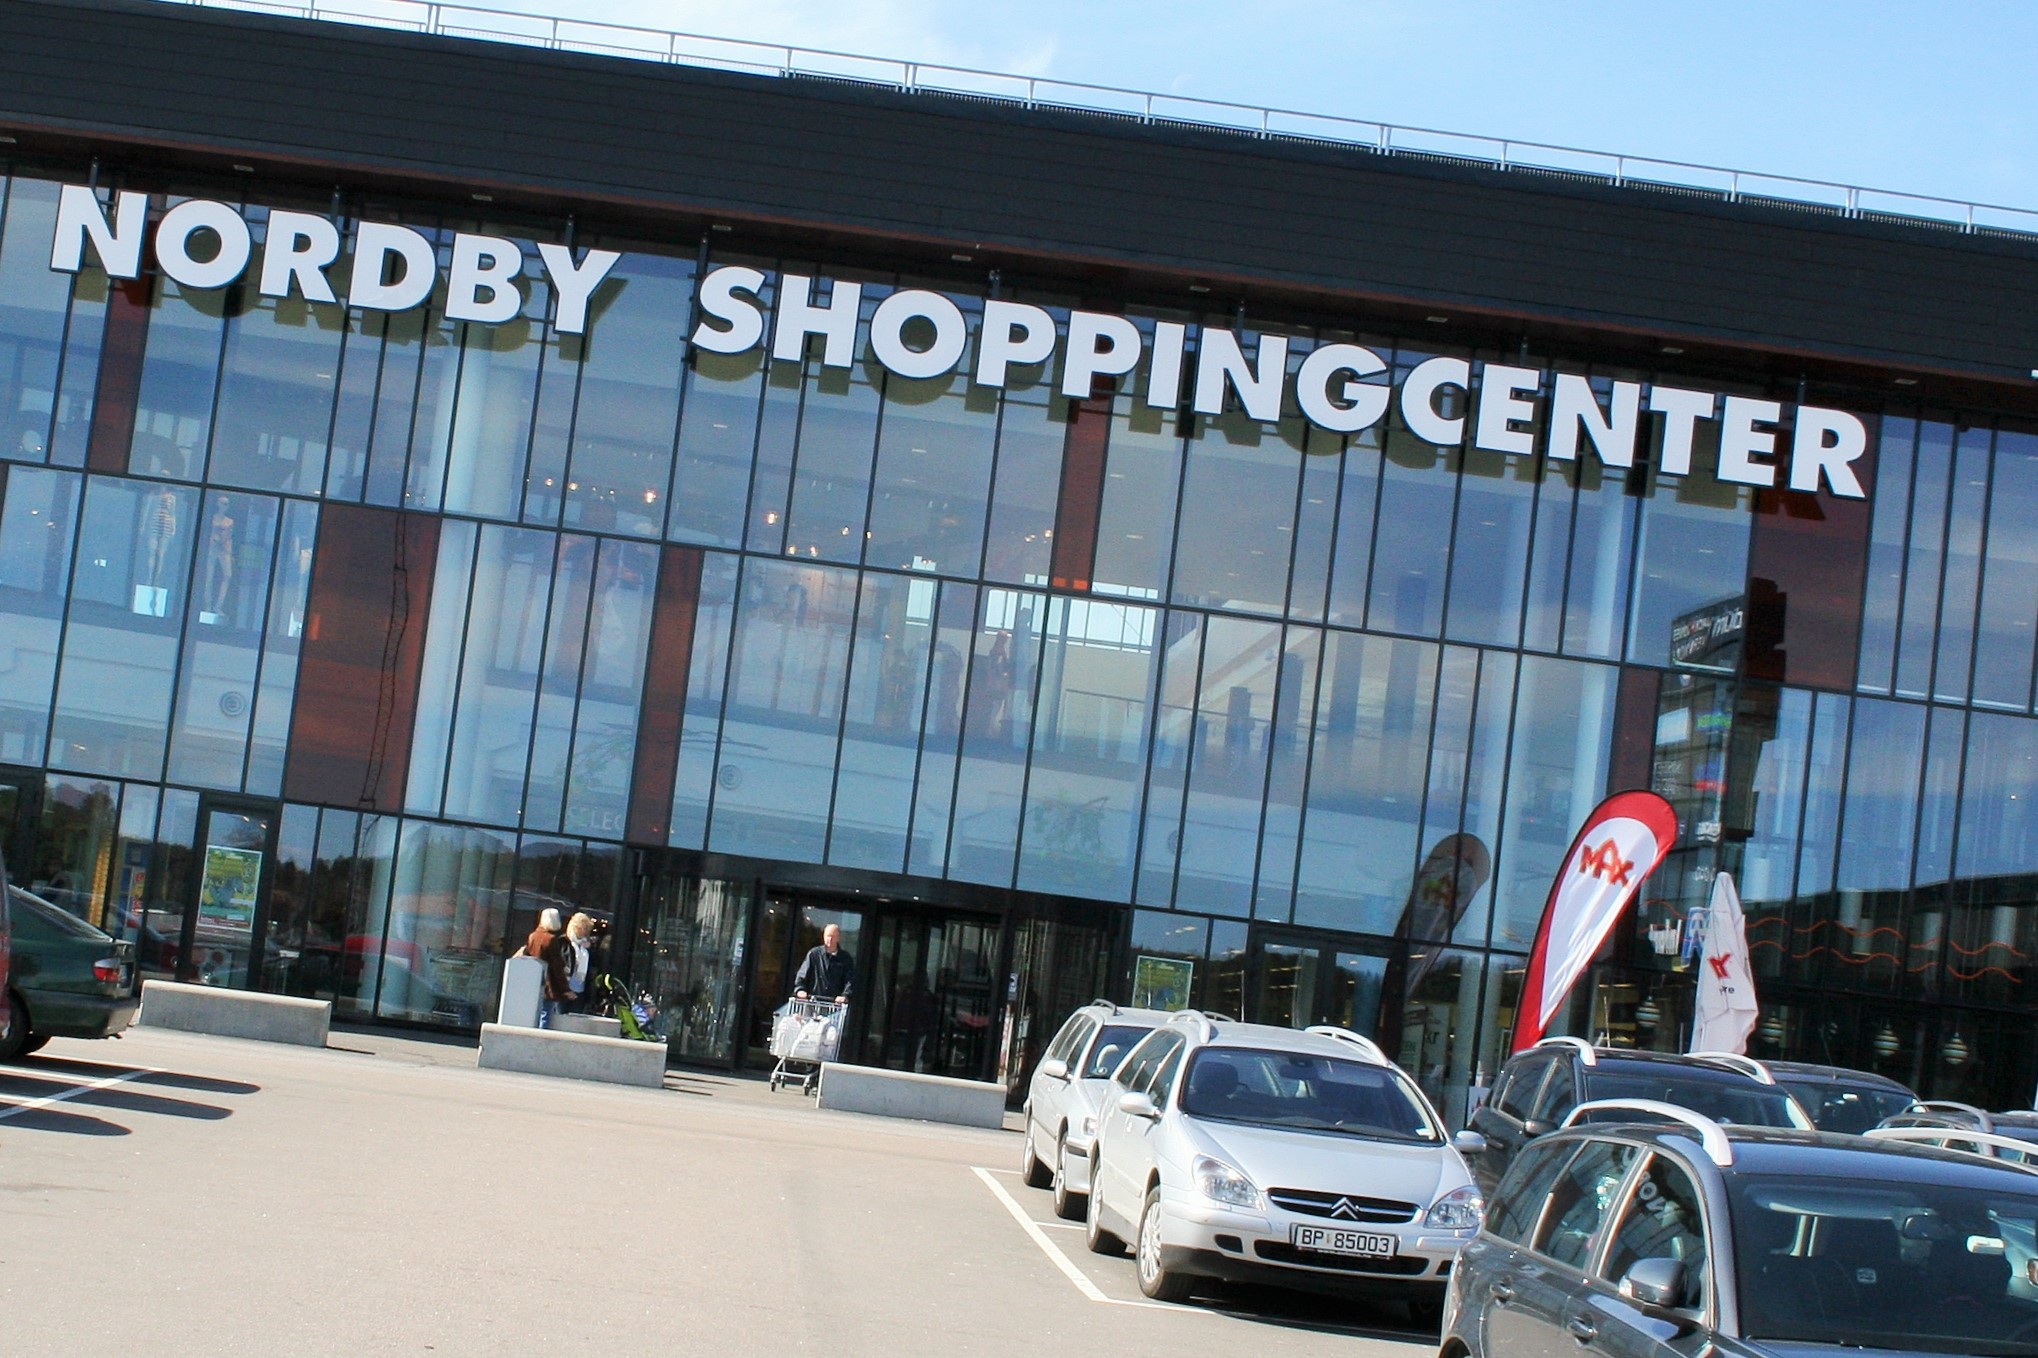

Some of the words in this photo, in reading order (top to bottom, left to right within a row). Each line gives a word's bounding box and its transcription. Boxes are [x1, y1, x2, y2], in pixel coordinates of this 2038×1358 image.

[50, 183, 621, 336] NORDBY
[691, 265, 1869, 500] SHOPPINGCENTER
[1579, 837, 1635, 888] MAX
[1301, 1228, 1324, 1246] BP
[1334, 1232, 1390, 1253] 85003
